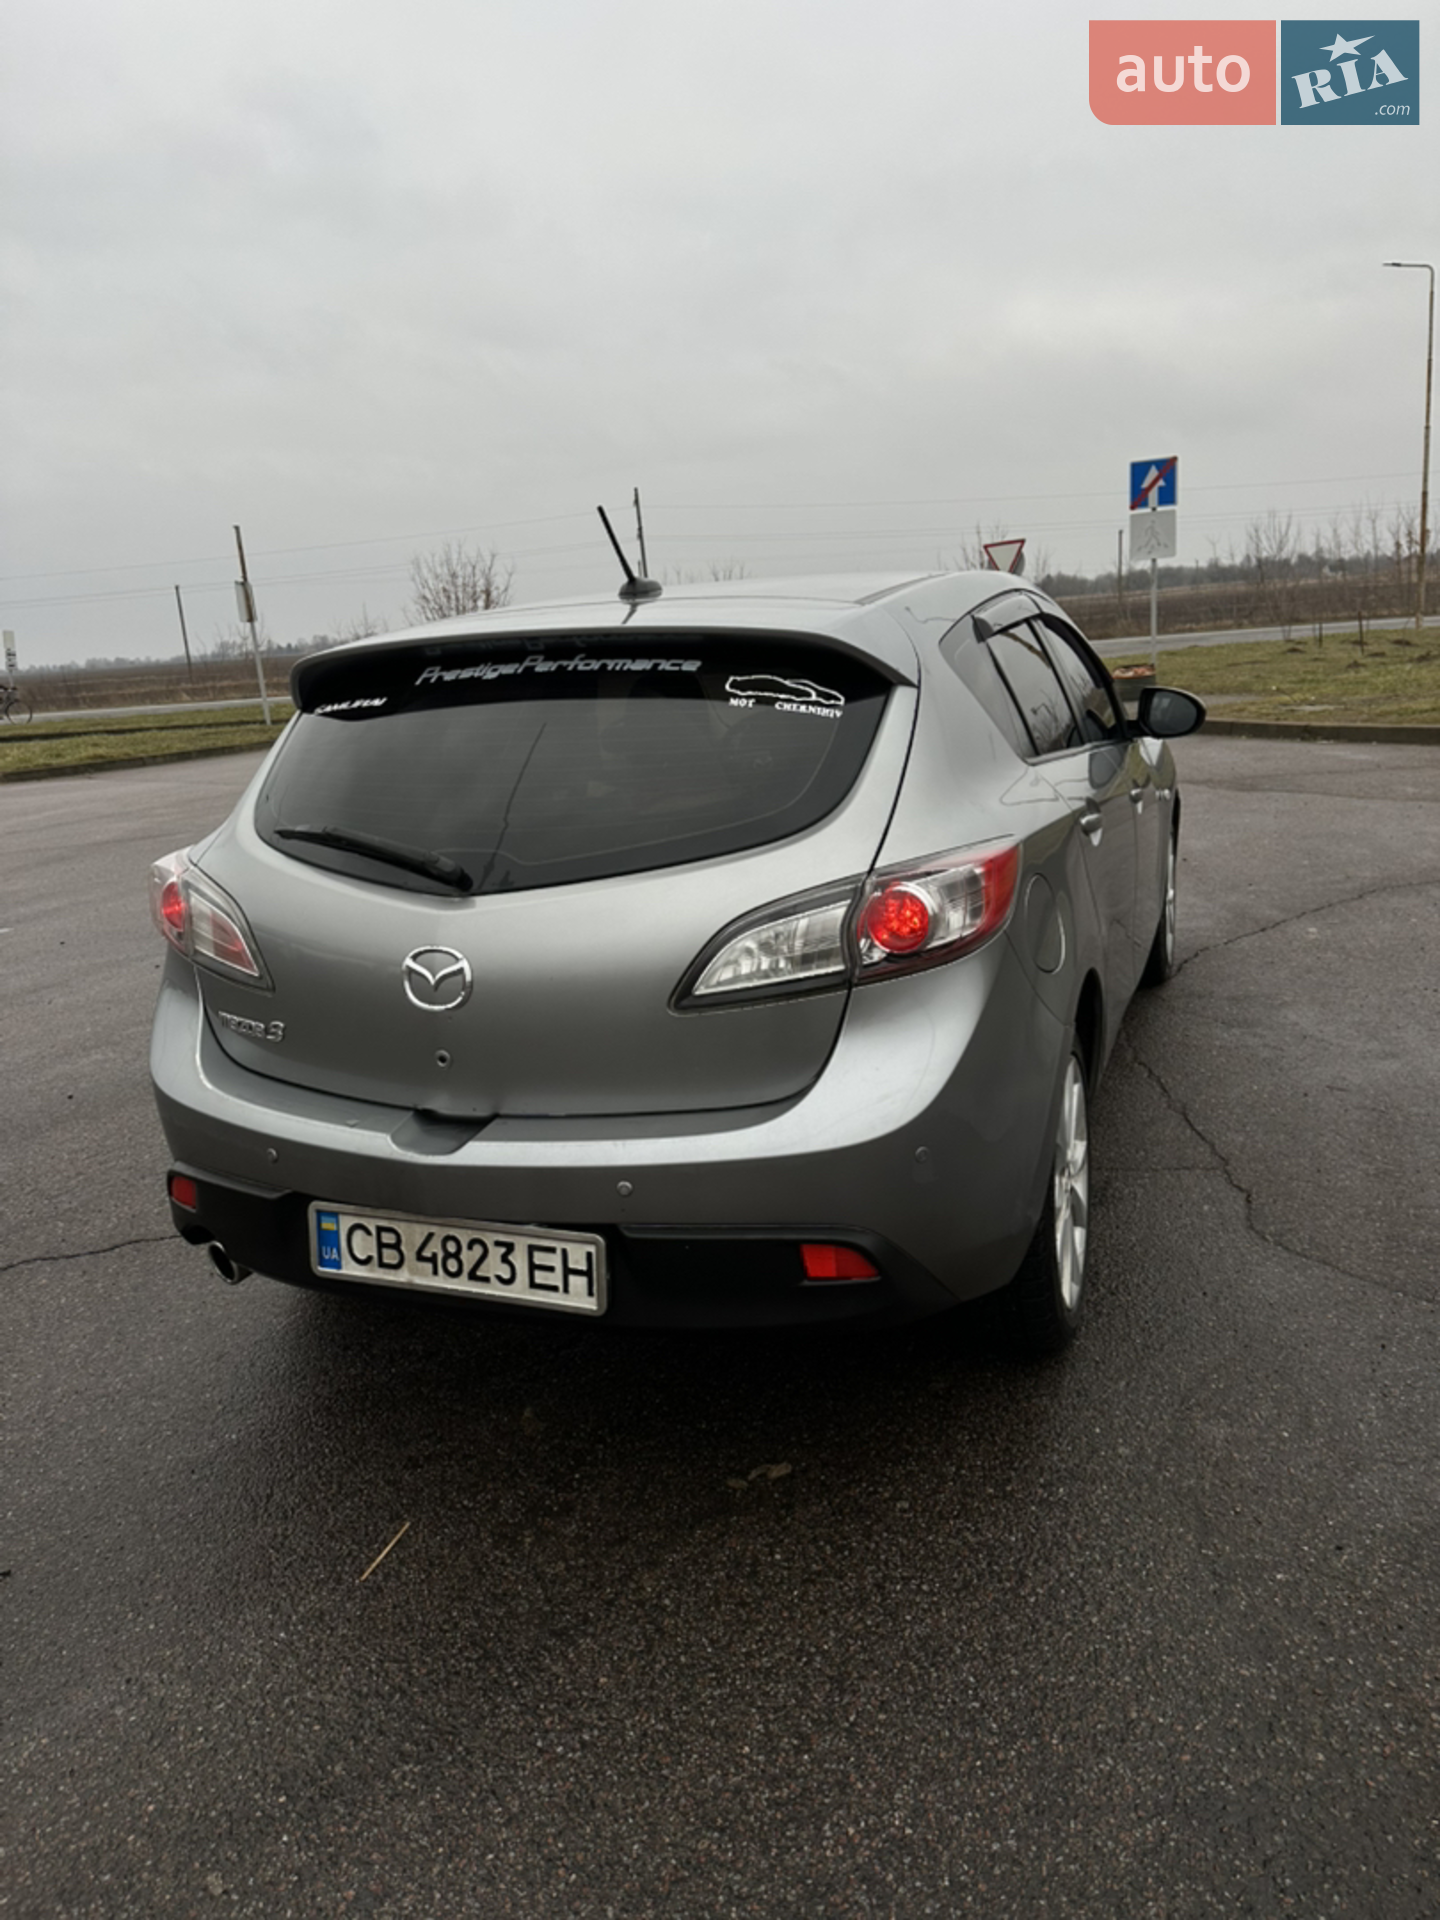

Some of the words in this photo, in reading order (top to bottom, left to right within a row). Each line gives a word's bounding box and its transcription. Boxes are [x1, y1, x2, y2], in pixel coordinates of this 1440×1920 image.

[321, 1245, 340, 1261] UA
[346, 1222, 406, 1271] CB
[415, 1231, 517, 1286] 4823
[526, 1242, 595, 1298] EH
